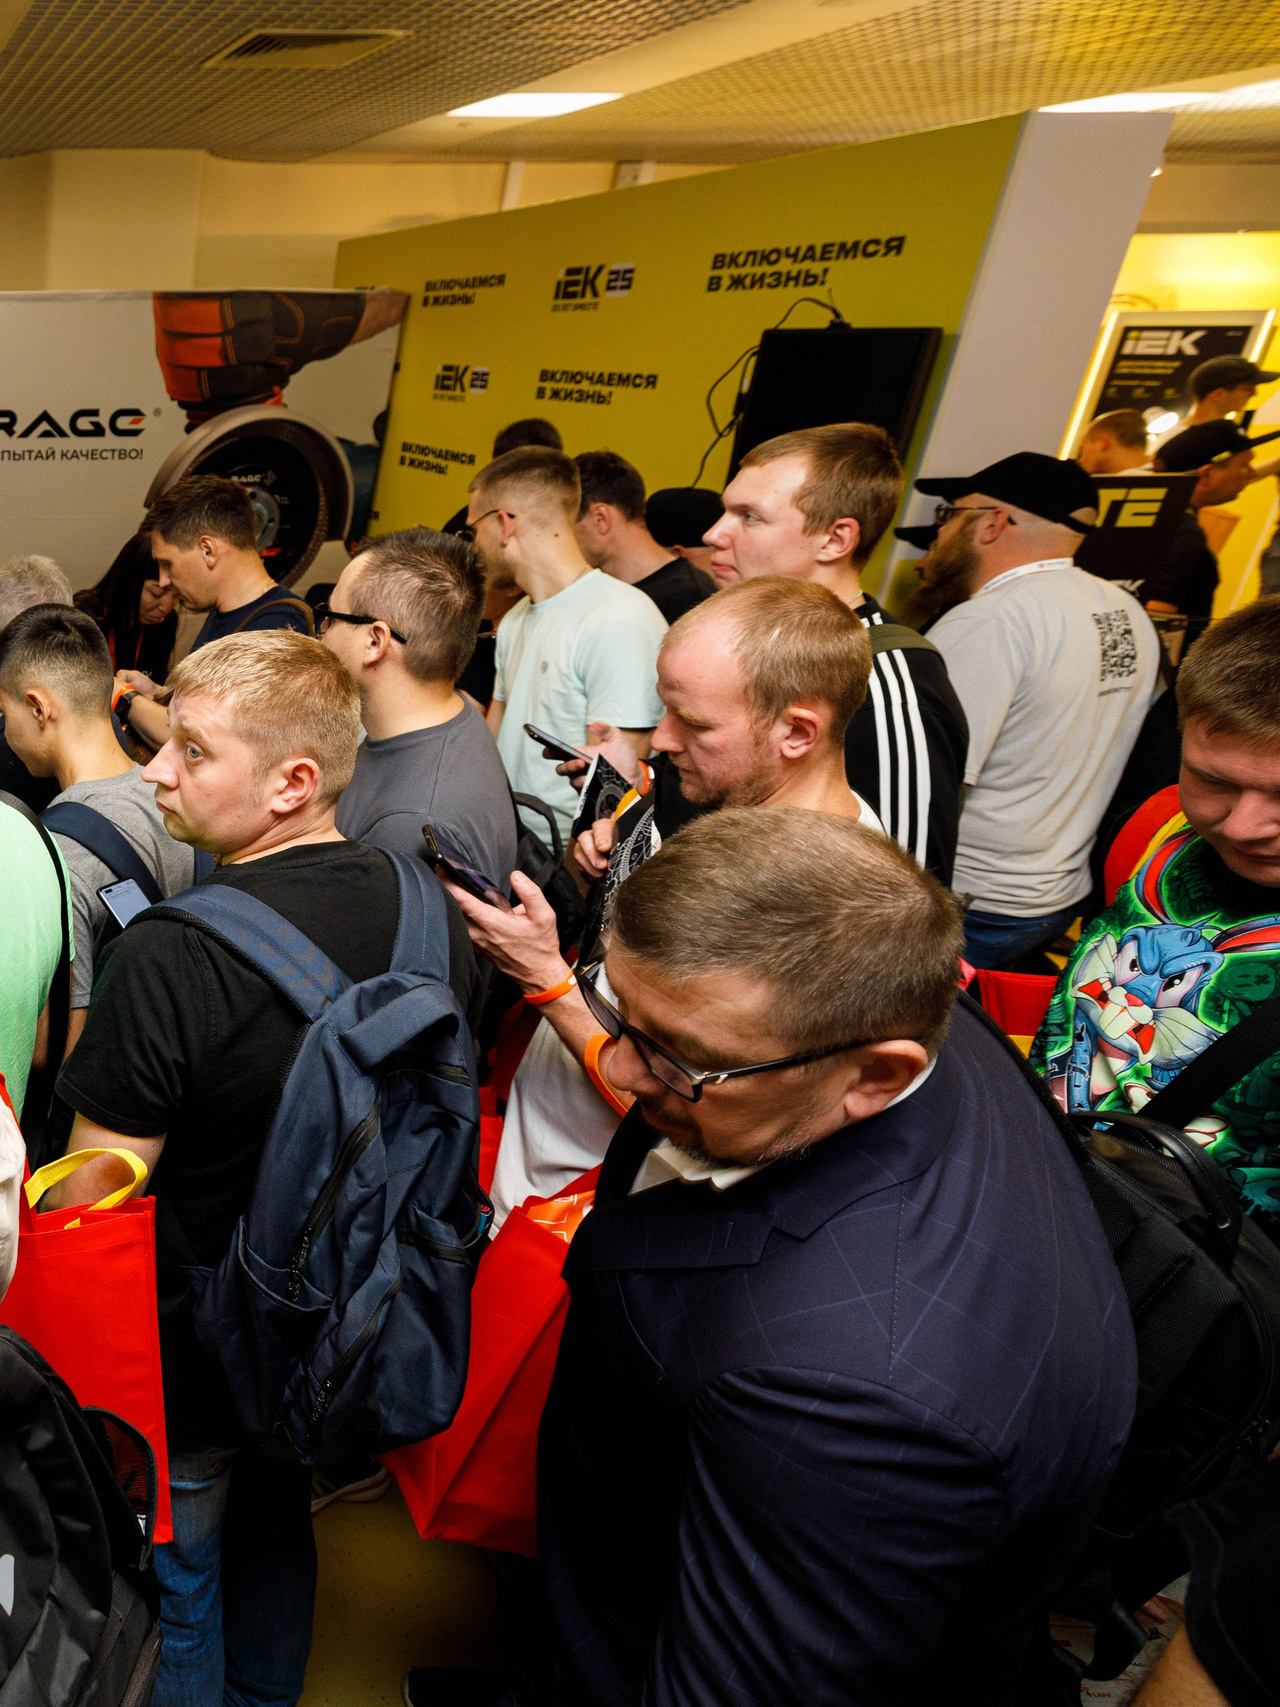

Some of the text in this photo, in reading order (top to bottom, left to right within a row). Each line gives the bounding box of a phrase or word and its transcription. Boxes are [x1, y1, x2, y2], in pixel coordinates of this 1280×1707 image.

[711, 236, 907, 271] ВКЛЮЧАЕМСЯ
[424, 273, 507, 293] ВКЛЮЧАЕМСЯ
[706, 267, 830, 293] В ЖИЗНЬ!
[422, 292, 476, 307] В ЖИЗНЬ!
[539, 369, 659, 389] ВКЛЮЧАЕМСЯ
[536, 386, 613, 405] В ЖИЗНЬ!
[60, 448, 144, 461] КАЧЕСТВО!
[401, 441, 476, 466] ВКЛЮЧАЕМСЯ
[399, 455, 449, 476] В ЖИЗНЬ!
